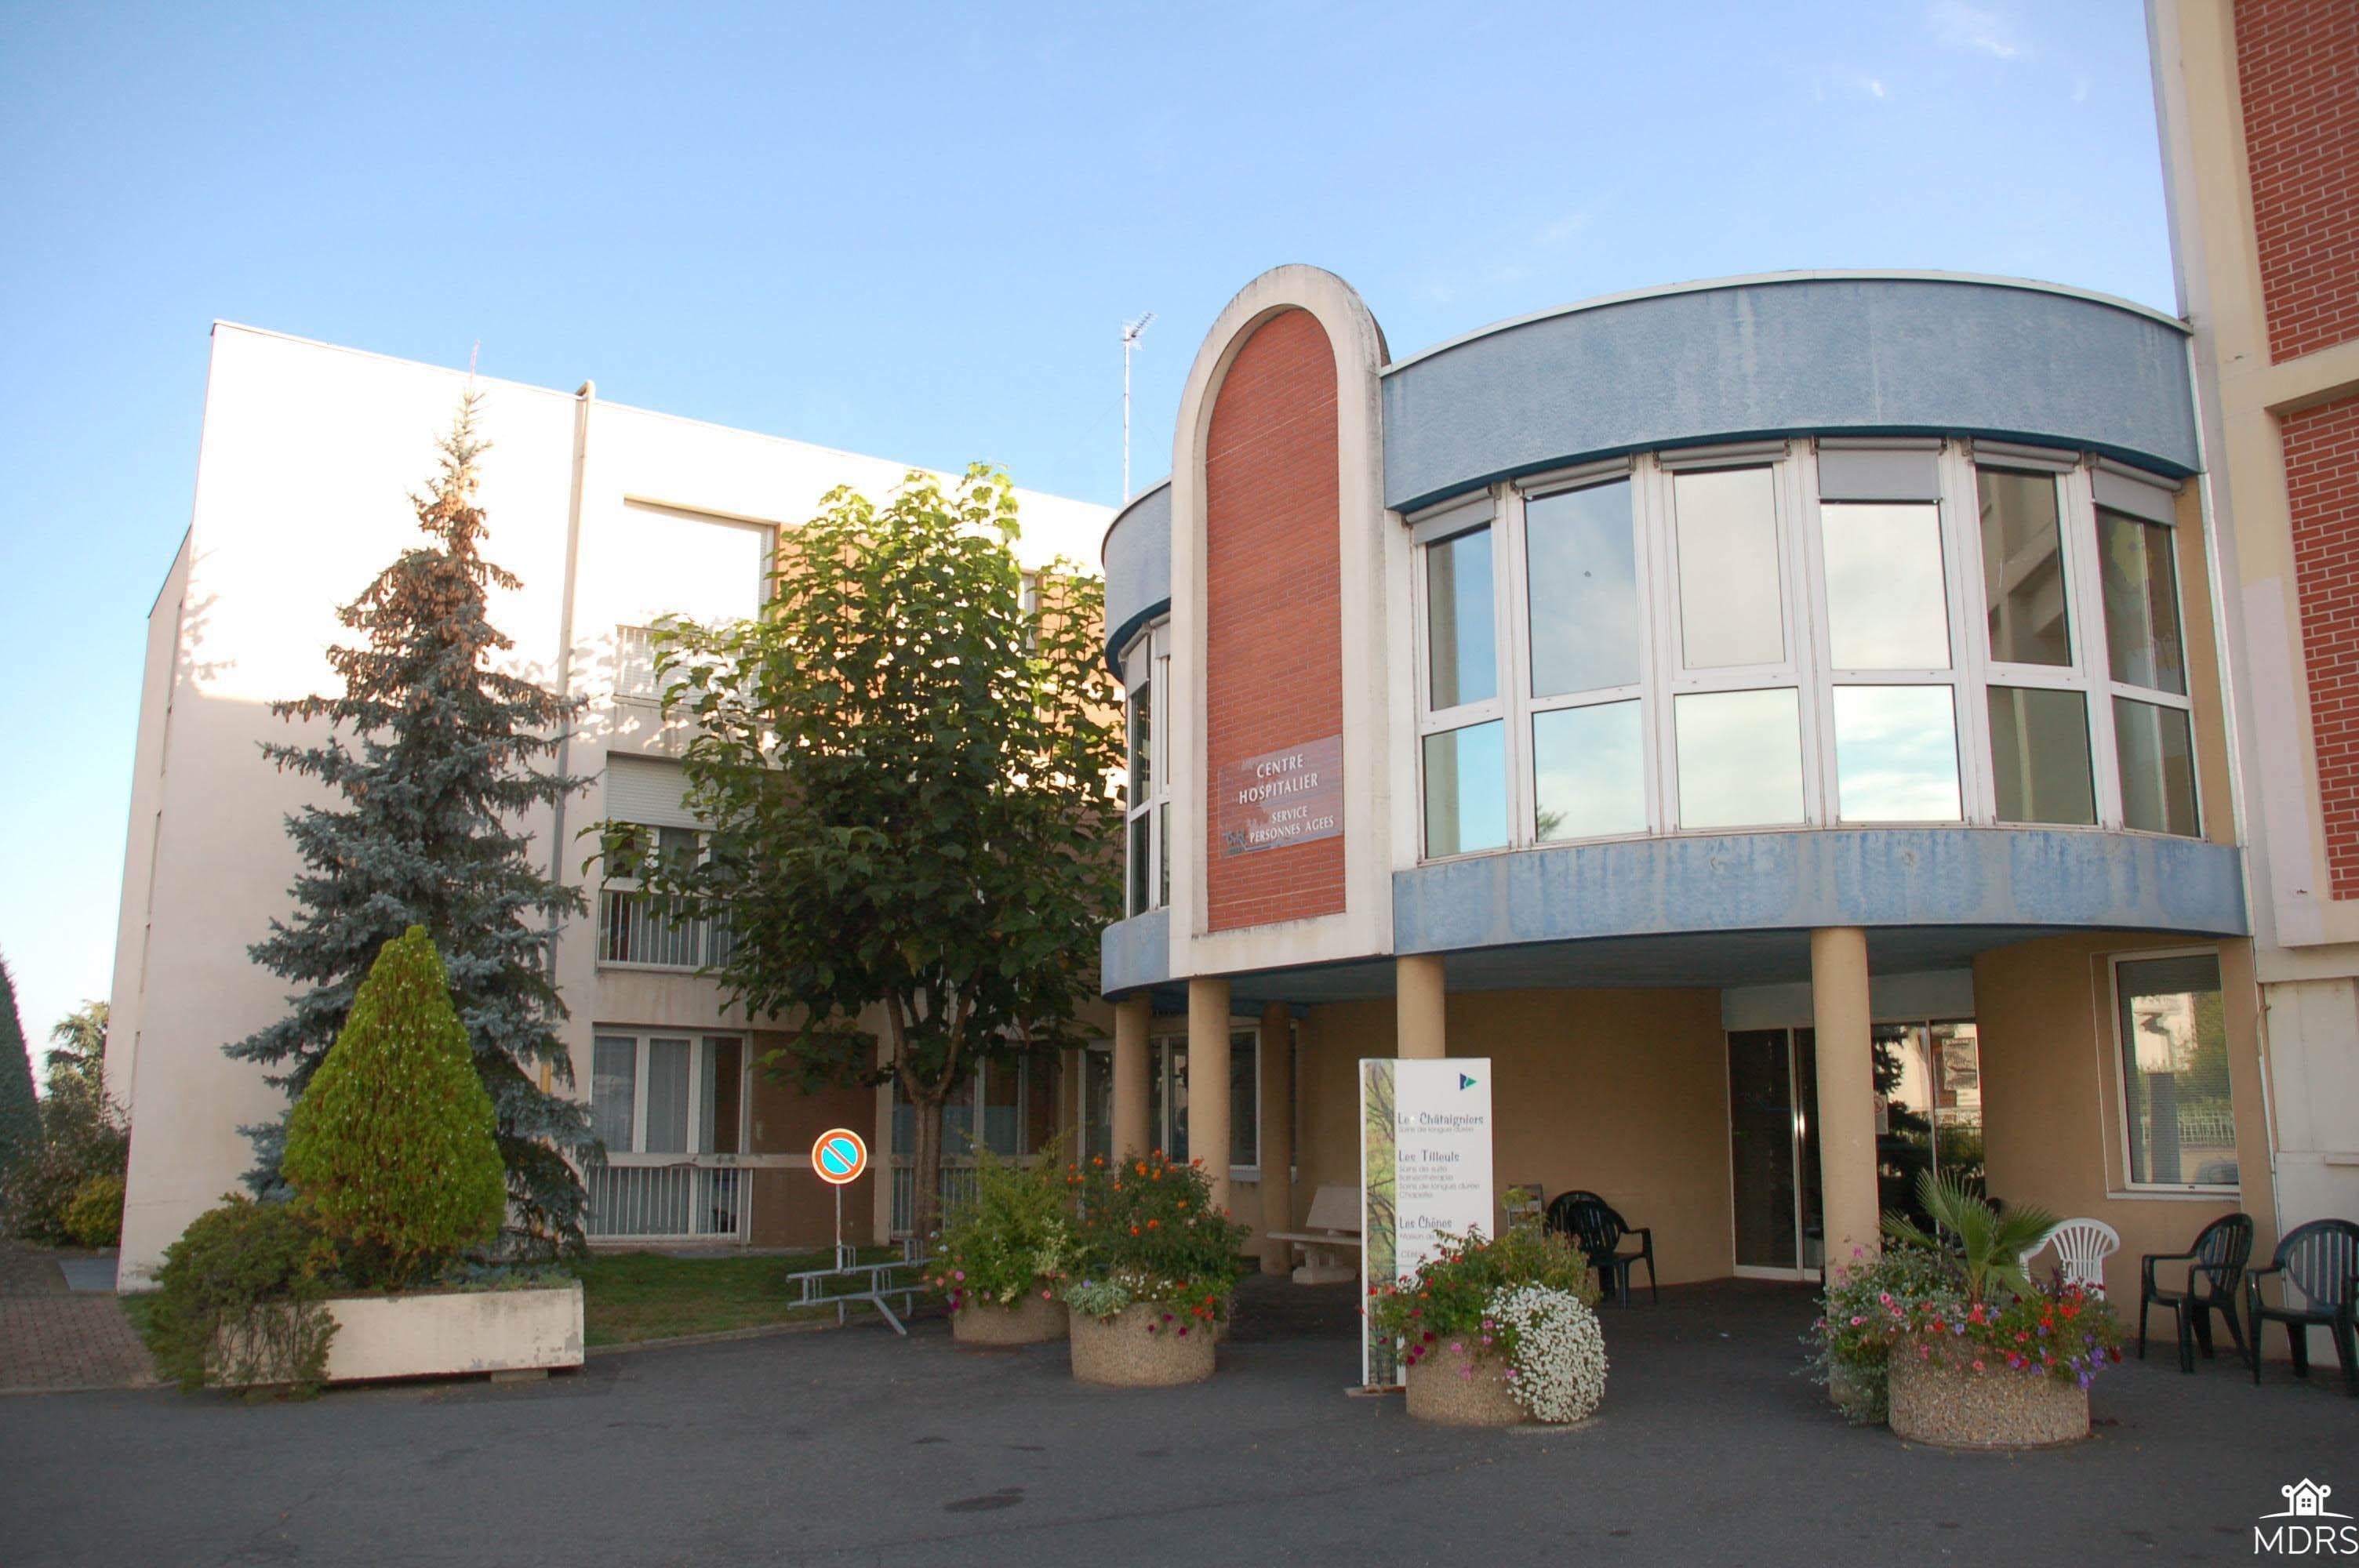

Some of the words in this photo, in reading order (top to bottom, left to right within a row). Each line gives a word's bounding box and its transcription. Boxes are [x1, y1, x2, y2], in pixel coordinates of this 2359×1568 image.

[1256, 753, 1303, 779] CENTRE
[1238, 772, 1318, 805] HOSPITALIER
[1271, 805, 1308, 823] SERVICE
[1249, 822, 1301, 844] PERSONNES
[1398, 1112, 1414, 1125] Le
[1398, 1150, 1416, 1162] Les
[1422, 1149, 1460, 1162] Tilleuls
[1399, 1217, 1415, 1229] Les
